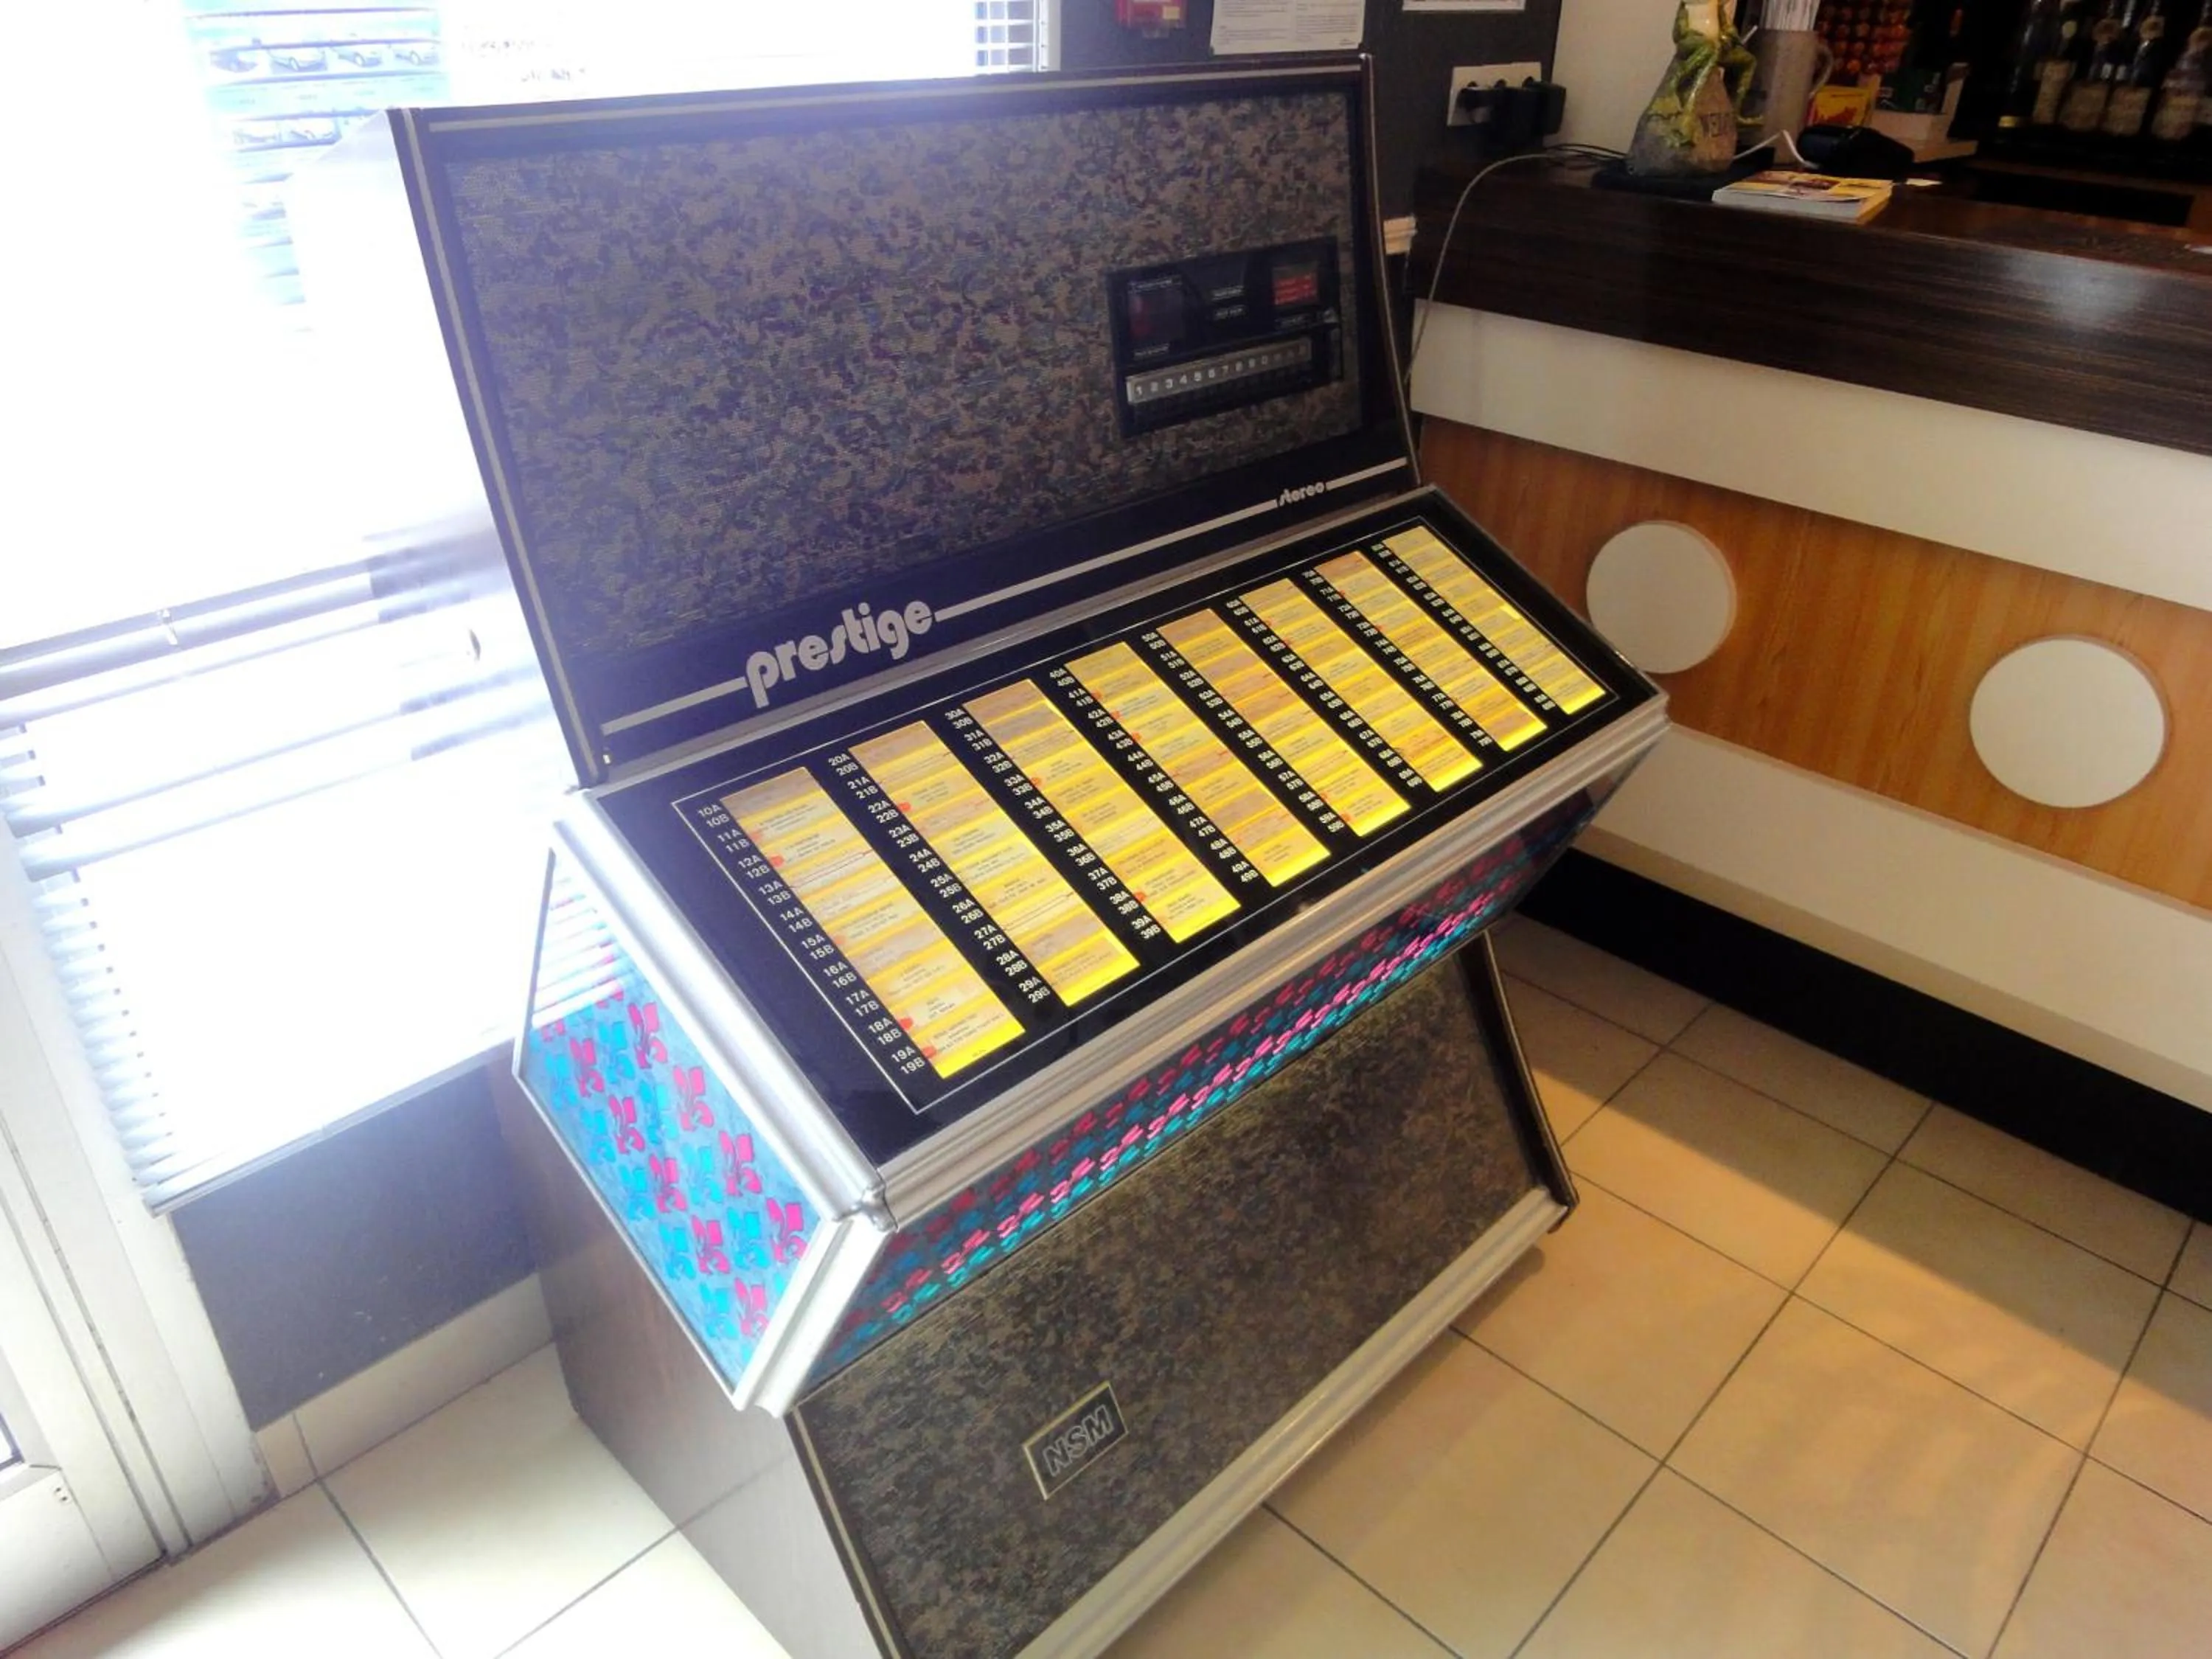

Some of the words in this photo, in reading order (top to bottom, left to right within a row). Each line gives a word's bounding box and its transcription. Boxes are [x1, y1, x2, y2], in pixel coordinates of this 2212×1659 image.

[1279, 481, 1325, 507] stereo
[745, 600, 932, 709] prestige
[945, 708, 964, 720] 30A
[952, 717, 973, 728] 30B
[964, 729, 984, 741] 31A
[971, 738, 992, 751] 31B
[828, 753, 850, 765] 20A
[984, 751, 1004, 764] 32A
[835, 762, 858, 776] 20B
[992, 760, 1012, 773] 32B
[847, 776, 870, 789] 21A
[1004, 773, 1024, 786] 33A
[855, 785, 877, 799] 21B
[1012, 782, 1032, 795] 33B
[868, 800, 890, 813] 22A
[1024, 796, 1045, 809] 34A
[698, 804, 721, 817] 10A
[875, 809, 898, 823] 22B
[1032, 806, 1053, 818] 34B
[706, 813, 729, 827] 10B
[1045, 819, 1065, 832] 35A
[717, 829, 741, 841] 11A
[888, 824, 911, 838] 23A
[1053, 828, 1074, 842] 35B
[726, 838, 749, 852] 11B
[896, 832, 919, 848] 23B
[908, 848, 932, 862] 24A
[1066, 843, 1087, 856] 36A
[737, 855, 762, 868] 12A
[917, 858, 940, 872] 24B
[1074, 852, 1096, 866] 36B
[745, 864, 770, 878] 12B
[1088, 866, 1108, 880] 37A
[758, 880, 782, 894] 13A
[930, 873, 953, 887] 25A
[1096, 876, 1116, 889] 37B
[767, 890, 790, 904] 13B
[939, 883, 961, 897] 25B
[1109, 890, 1130, 904] 38A
[952, 898, 975, 914] 26A
[1118, 900, 1138, 914] 38B
[779, 907, 803, 920] 14A
[960, 908, 983, 924] 26B
[788, 917, 813, 932] 14B
[1131, 915, 1152, 929] 39A
[973, 924, 997, 939] 27A
[1140, 924, 1161, 939] 39B
[801, 933, 824, 948] 15A
[983, 934, 1005, 950] 27B
[810, 944, 834, 959] 15B
[995, 950, 1019, 965] 28A
[823, 961, 847, 976] 16A
[1004, 959, 1027, 976] 28B
[832, 972, 856, 987] 16B
[1018, 976, 1041, 992] 29A
[846, 990, 869, 1004] 17A
[1028, 986, 1050, 1003] 29B
[855, 1000, 879, 1016] 17B
[868, 1017, 892, 1033] 18A
[877, 1028, 901, 1045] 18B
[891, 1046, 915, 1062] 19A
[900, 1057, 925, 1074] 19B
[1042, 1404, 1115, 1478] NSM
